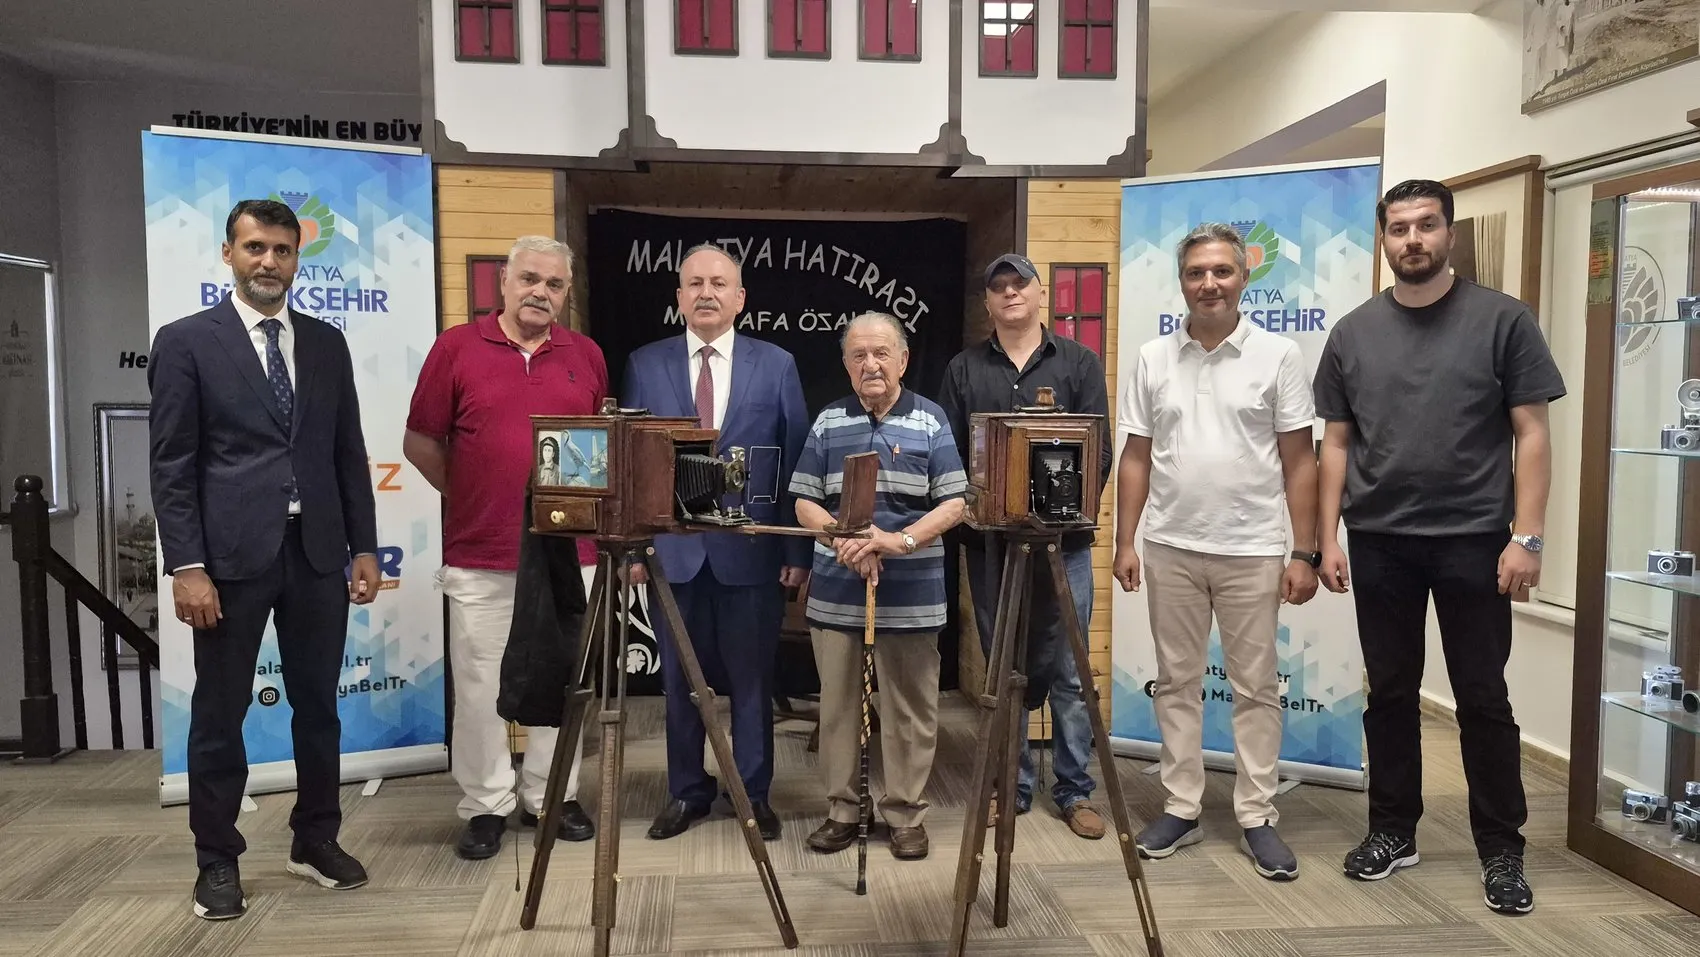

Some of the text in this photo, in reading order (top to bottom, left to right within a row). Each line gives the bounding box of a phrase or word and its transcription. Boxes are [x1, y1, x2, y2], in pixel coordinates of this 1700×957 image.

[335, 121, 367, 140] EN
[627, 236, 773, 273] MALTYA
[663, 305, 789, 332] MAFA
[119, 351, 148, 368] He
